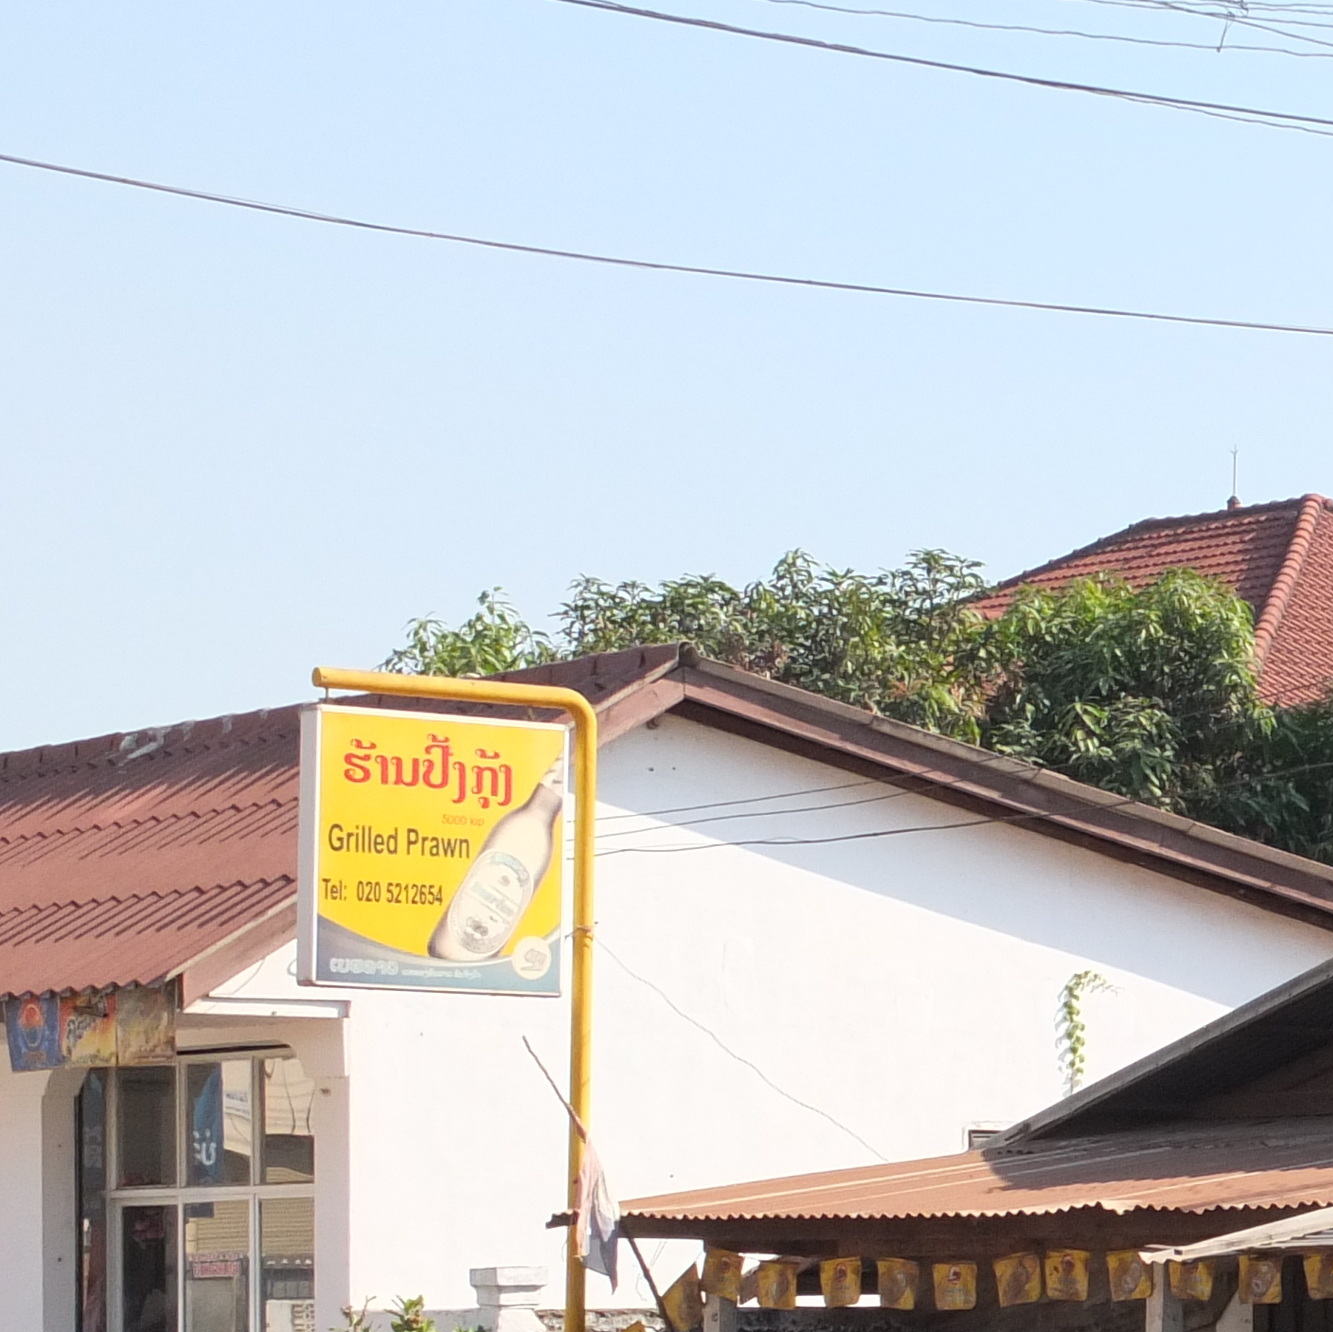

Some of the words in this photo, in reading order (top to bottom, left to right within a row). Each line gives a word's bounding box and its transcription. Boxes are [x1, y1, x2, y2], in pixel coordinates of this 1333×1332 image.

[328, 823, 399, 855] Grilled
[406, 828, 470, 859] Prawn
[322, 878, 347, 901] Tel:
[356, 880, 381, 902] 020
[386, 882, 443, 906] 5212654
